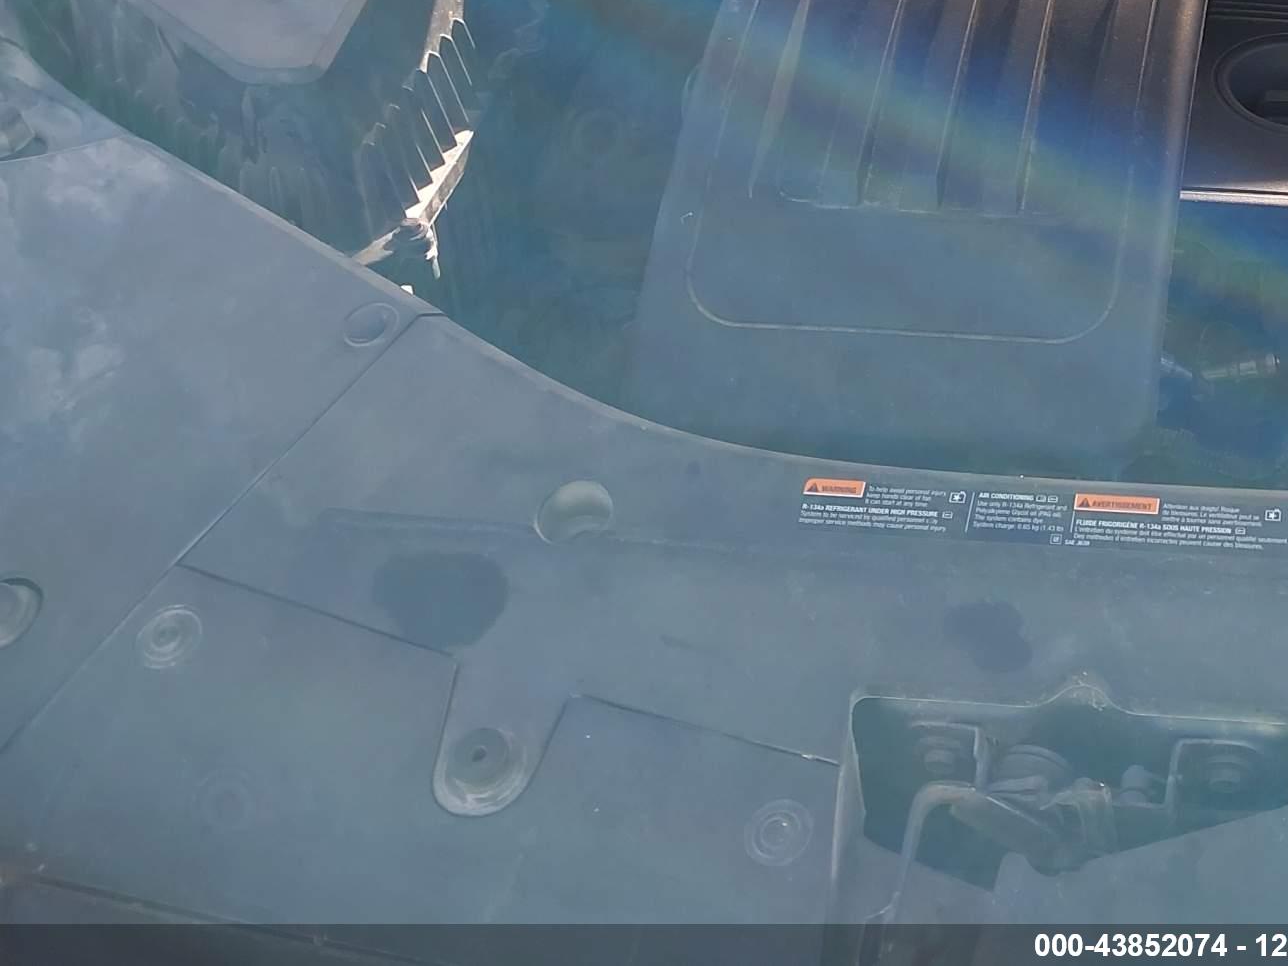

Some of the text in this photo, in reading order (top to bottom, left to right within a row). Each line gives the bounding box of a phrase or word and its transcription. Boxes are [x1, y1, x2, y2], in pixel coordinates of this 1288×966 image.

[990, 493, 1034, 501] CONDITIONING
[1092, 500, 1152, 510] AVERTISSEMENT
[825, 505, 867, 513] REFRIGERANT
[907, 510, 938, 518] PRESSURE
[1201, 526, 1232, 534] PRESSION
